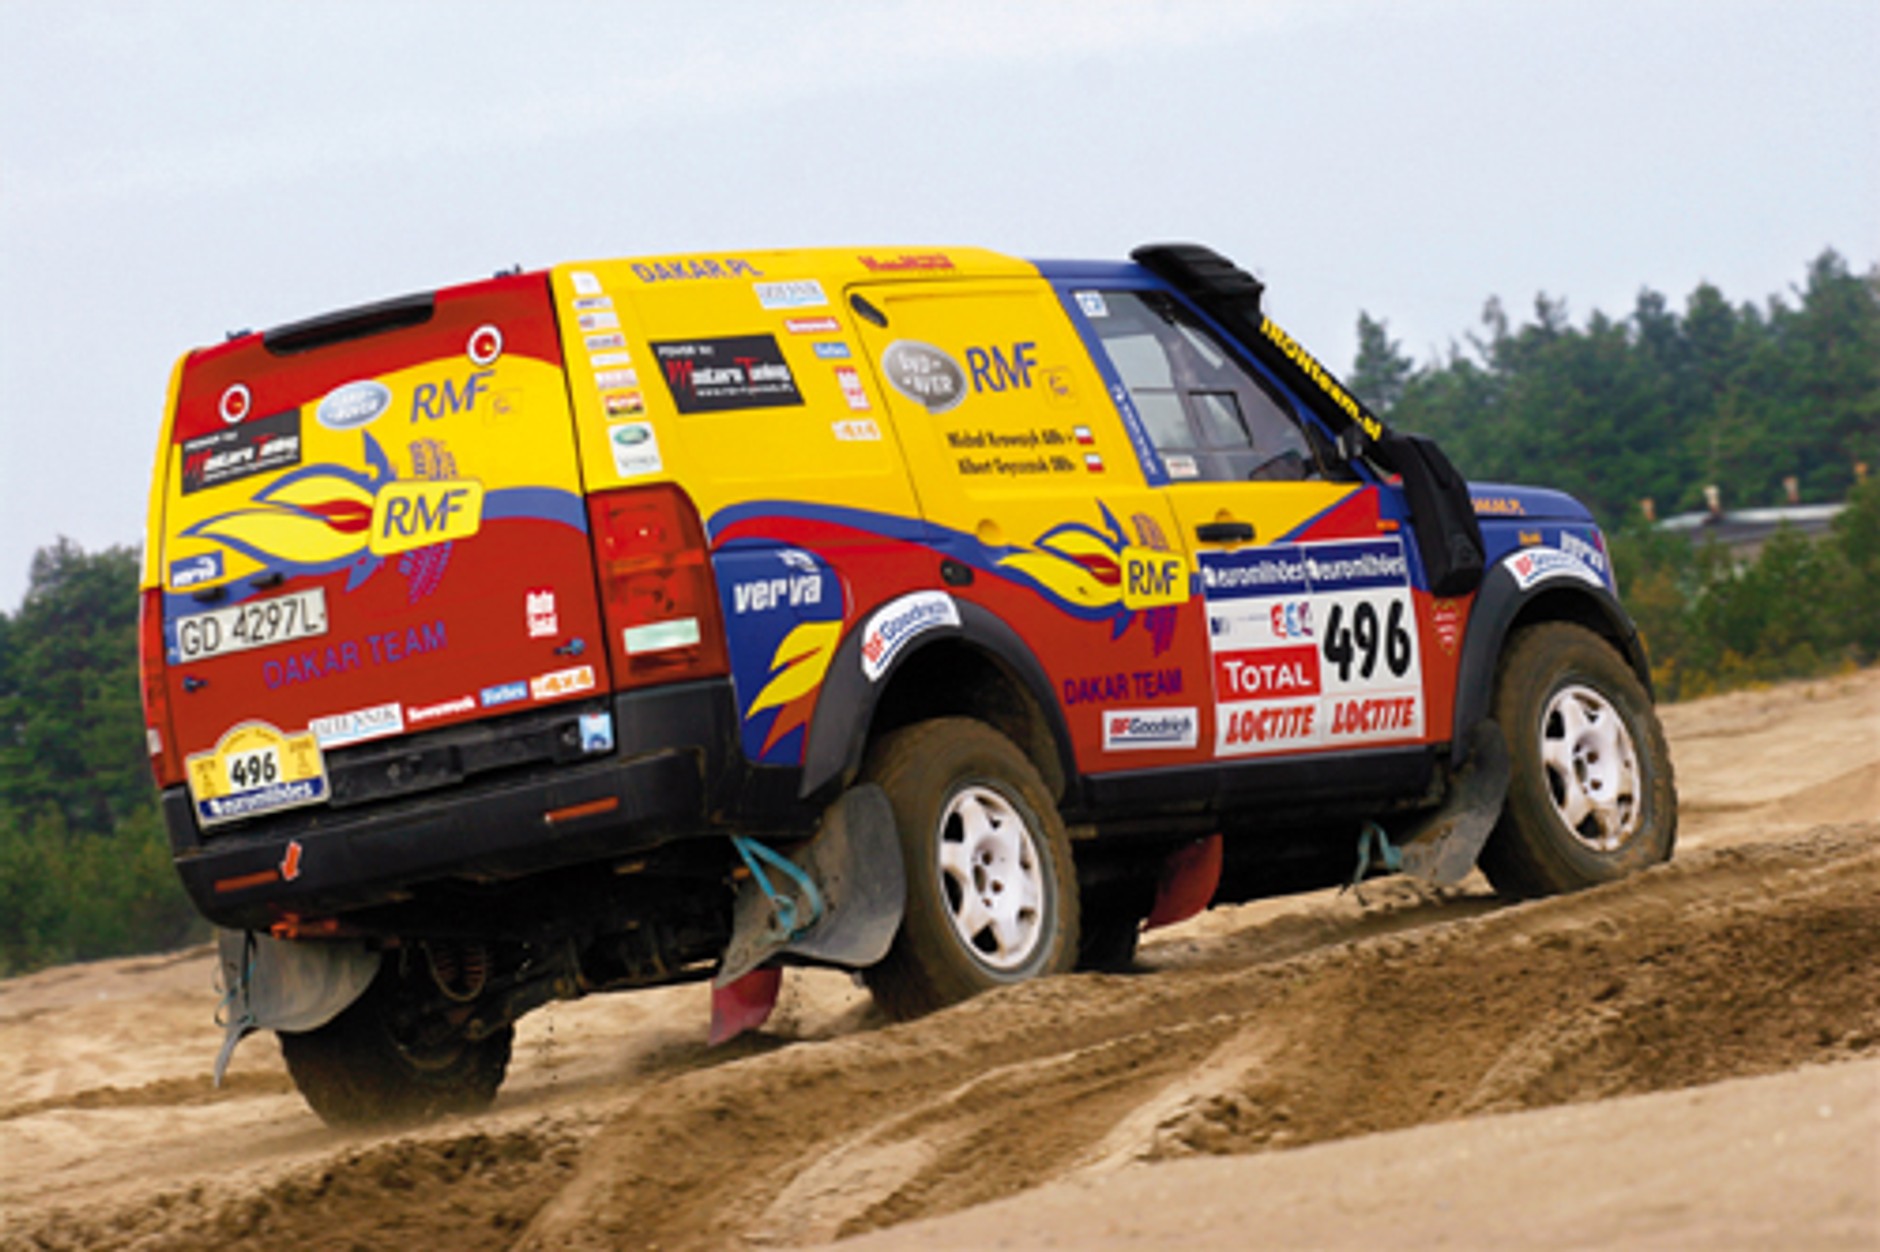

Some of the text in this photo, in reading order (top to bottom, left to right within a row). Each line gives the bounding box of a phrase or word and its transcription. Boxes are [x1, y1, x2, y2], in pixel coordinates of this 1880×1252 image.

[966, 341, 1037, 393] RMF
[410, 368, 496, 424] RMF
[384, 490, 468, 538] RMF
[734, 574, 822, 613] verva
[1128, 560, 1179, 596] RMF
[180, 597, 318, 655] GD 4297L
[1323, 599, 1412, 682] 496
[262, 620, 448, 690] DAKAR TEAM
[1064, 667, 1182, 705] DAKAR TEAM
[1110, 717, 1191, 737] BFGoodrich
[1225, 696, 1415, 745] LOCTITE LOCTITE
[231, 751, 277, 787] 496
